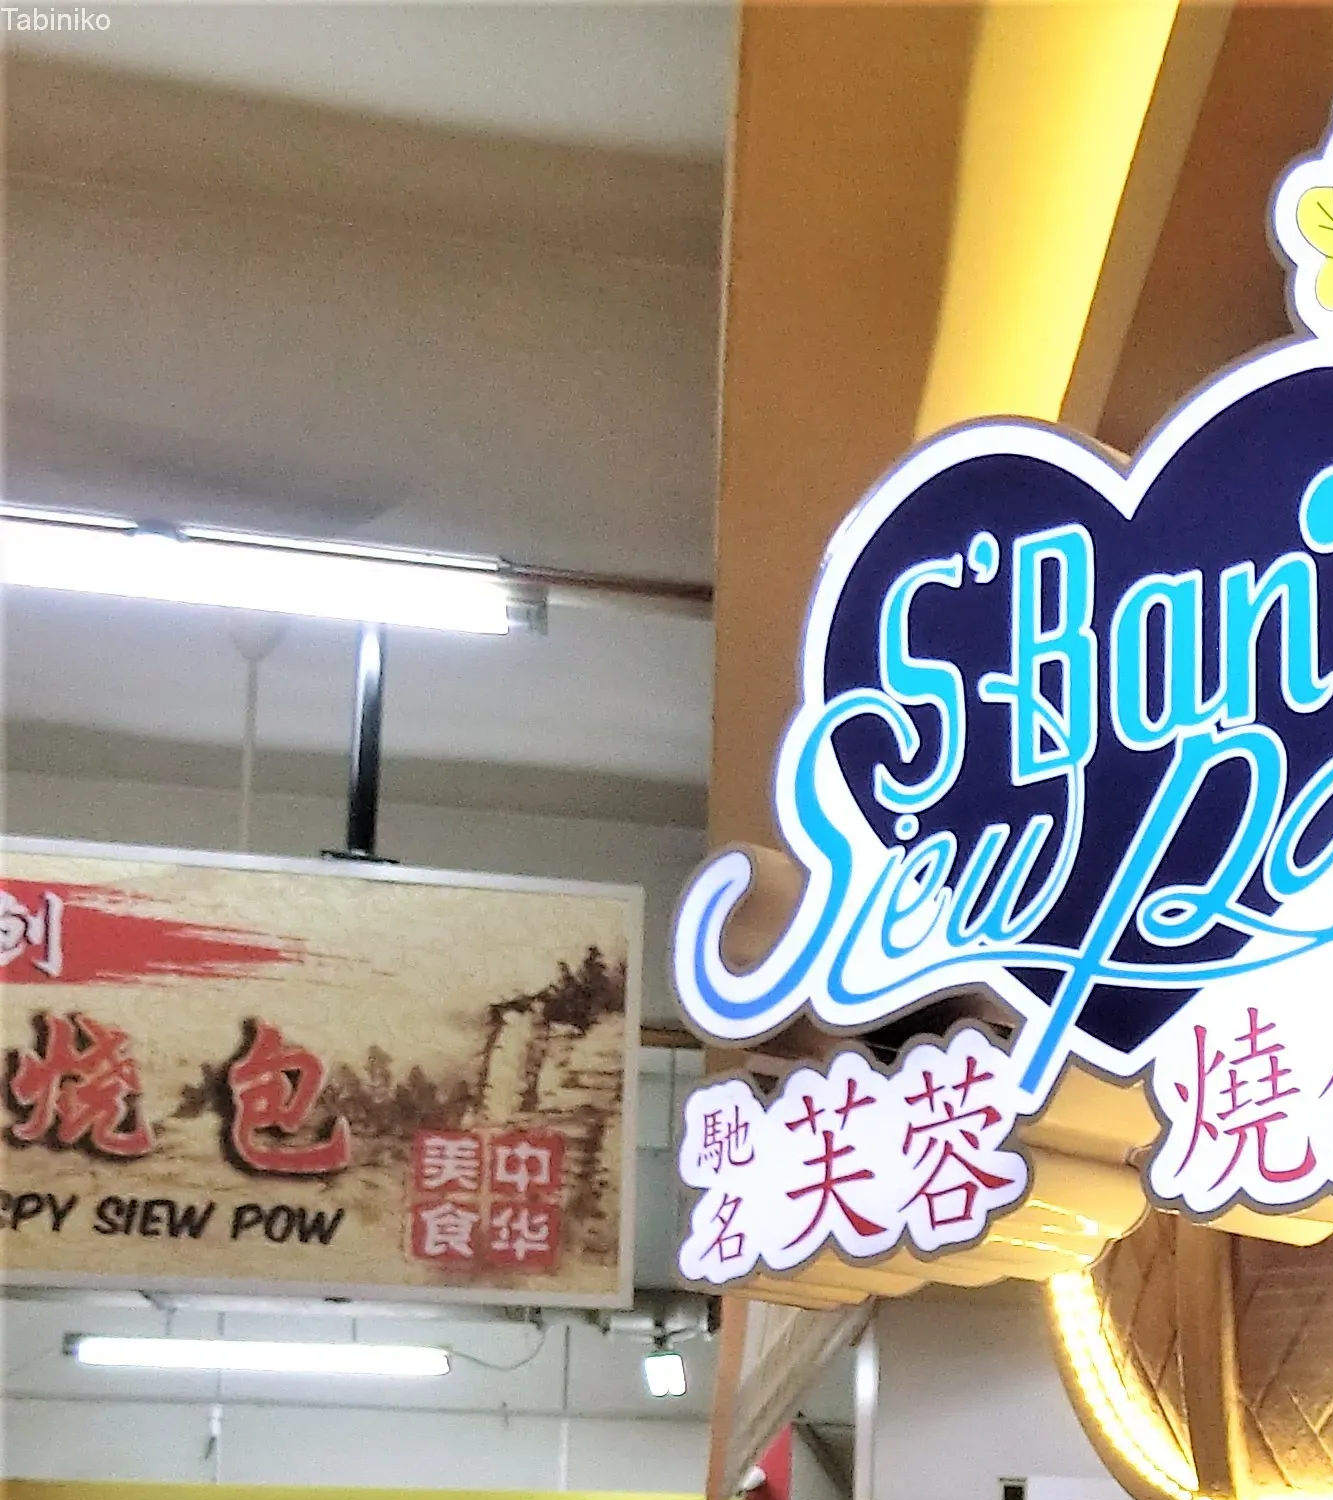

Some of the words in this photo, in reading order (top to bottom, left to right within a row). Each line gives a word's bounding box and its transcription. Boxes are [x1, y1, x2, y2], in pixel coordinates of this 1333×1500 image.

[695, 694, 1078, 1020] Siew
[93, 1195, 217, 1240] SIEW
[230, 1202, 346, 1245] POW
[783, 1056, 1015, 1250] 芙蓉
